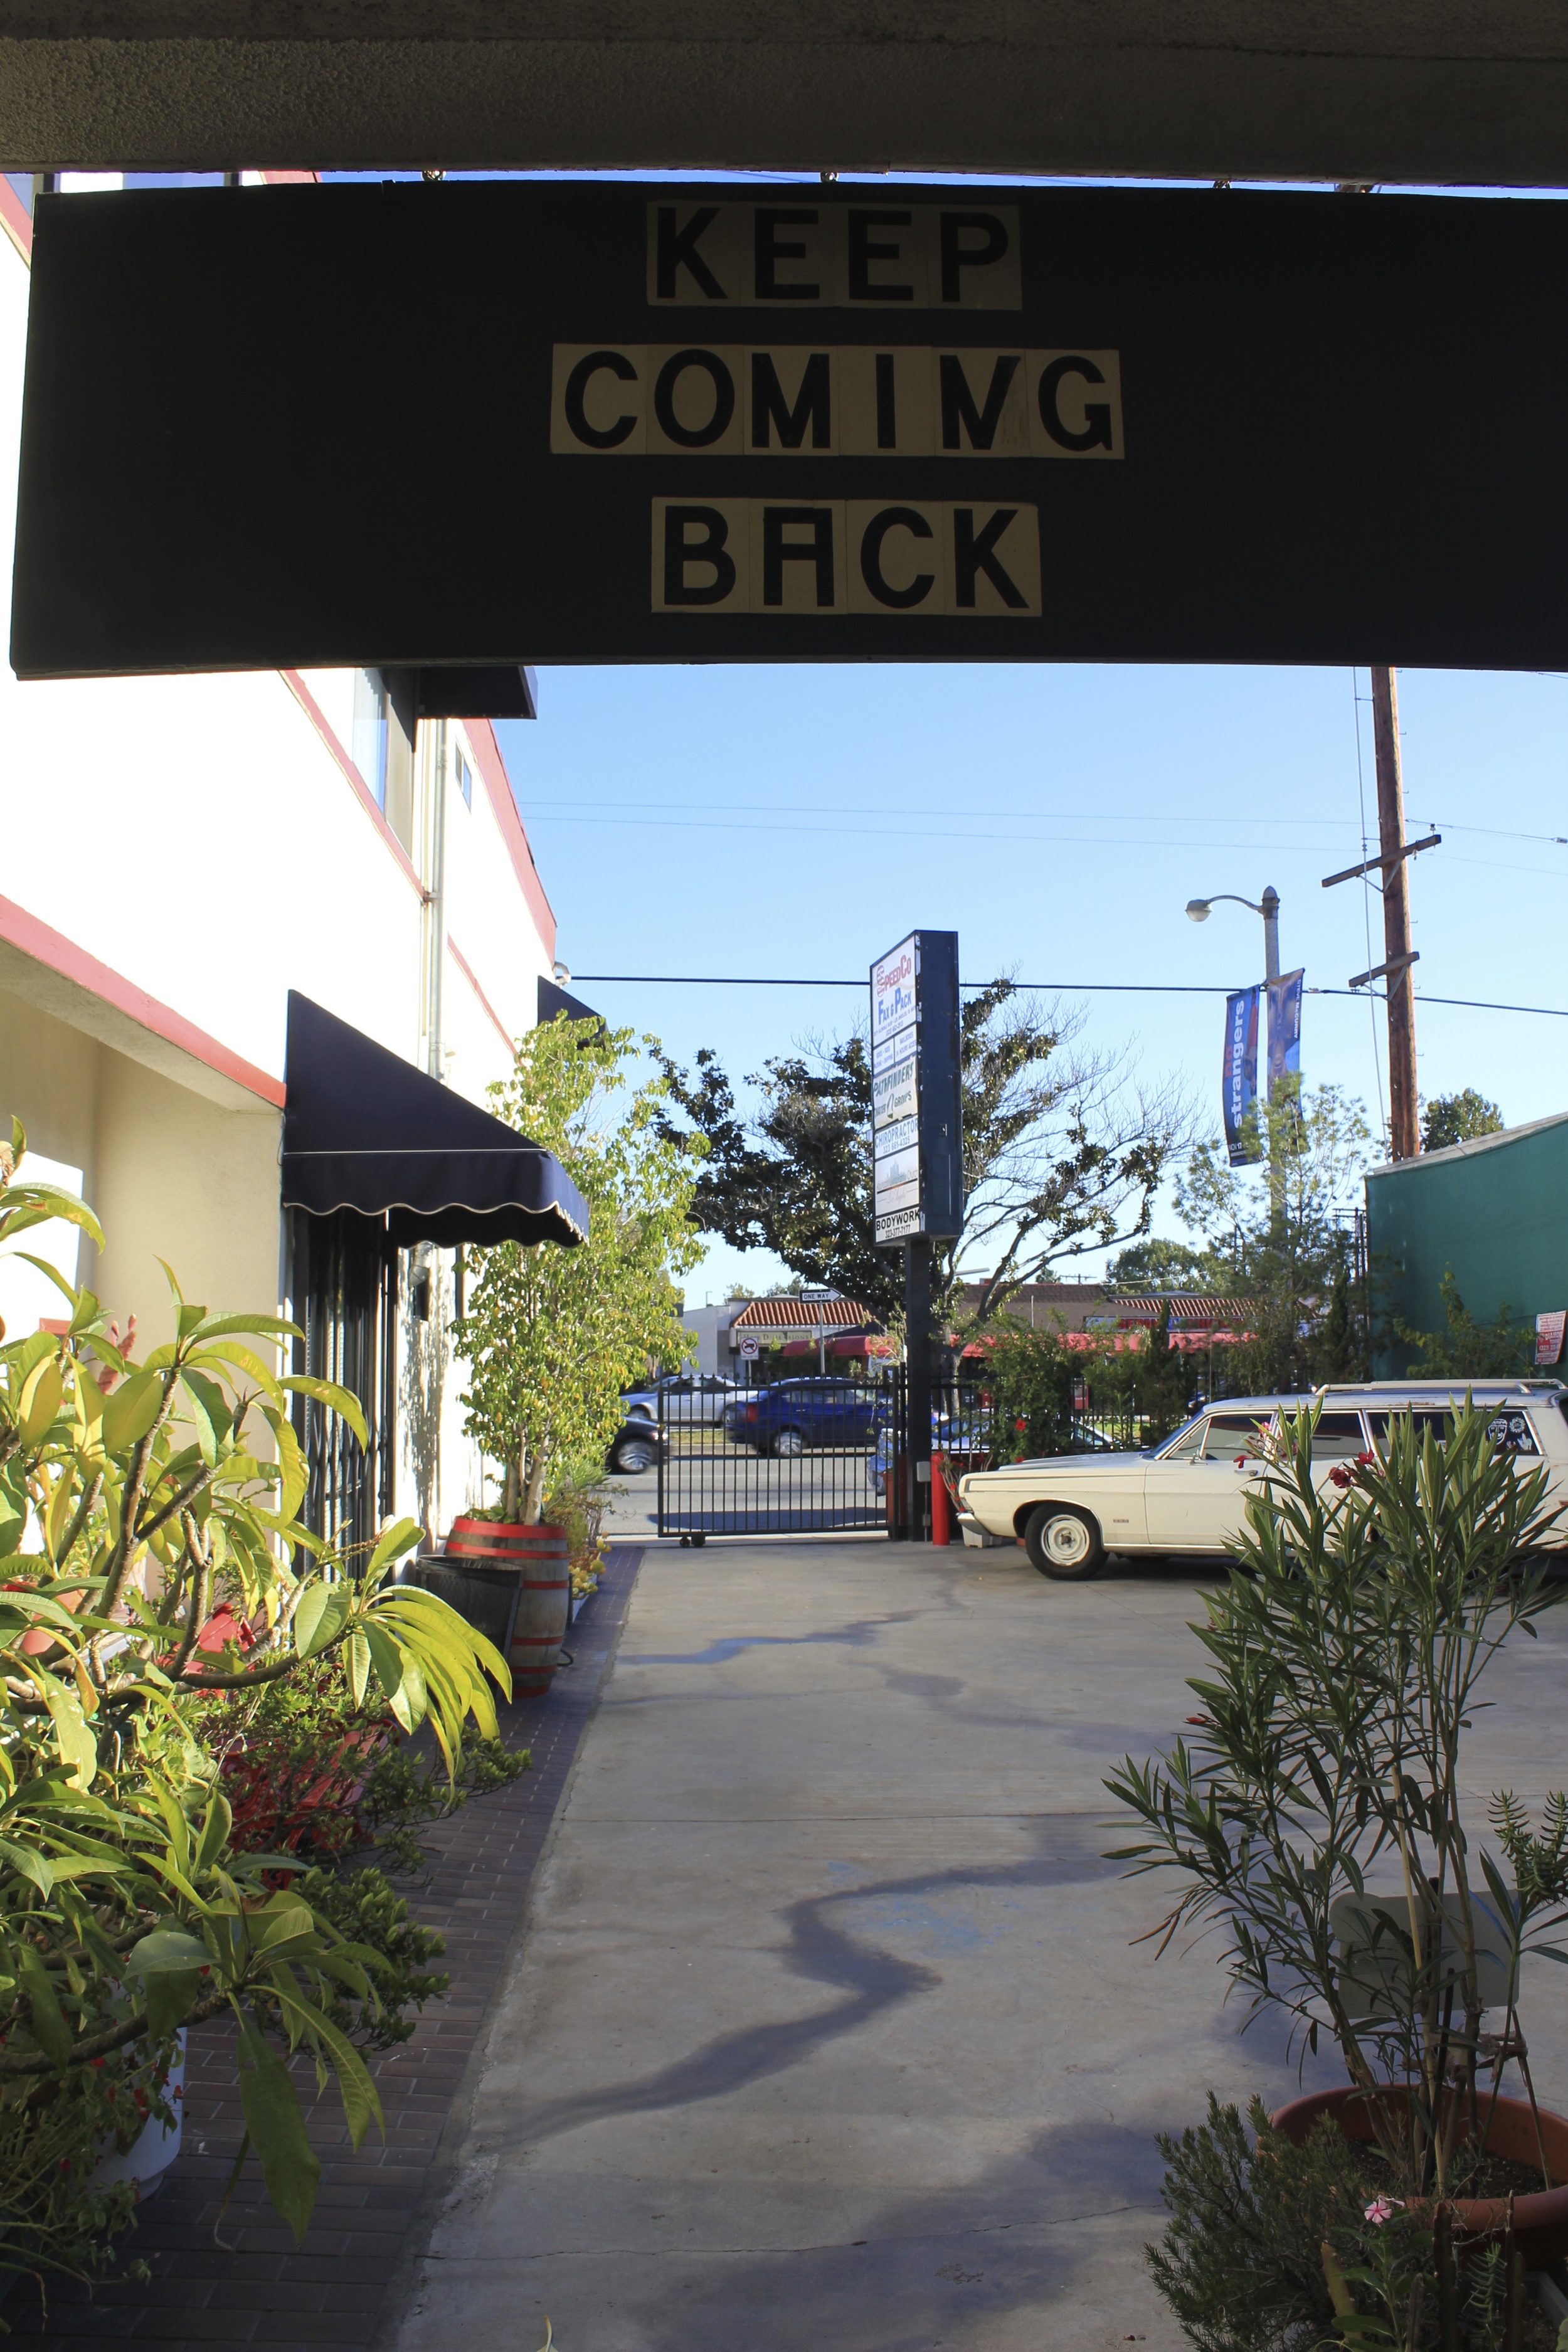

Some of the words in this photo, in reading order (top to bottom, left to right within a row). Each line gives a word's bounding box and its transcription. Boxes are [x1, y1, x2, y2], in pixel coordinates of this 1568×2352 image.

[656, 206, 1010, 304] KEEP
[663, 504, 1030, 610] BACK
[1225, 1045, 1234, 1077] no
[1231, 1000, 1245, 1129] strangers
[876, 1209, 920, 1231] BODYWORK
